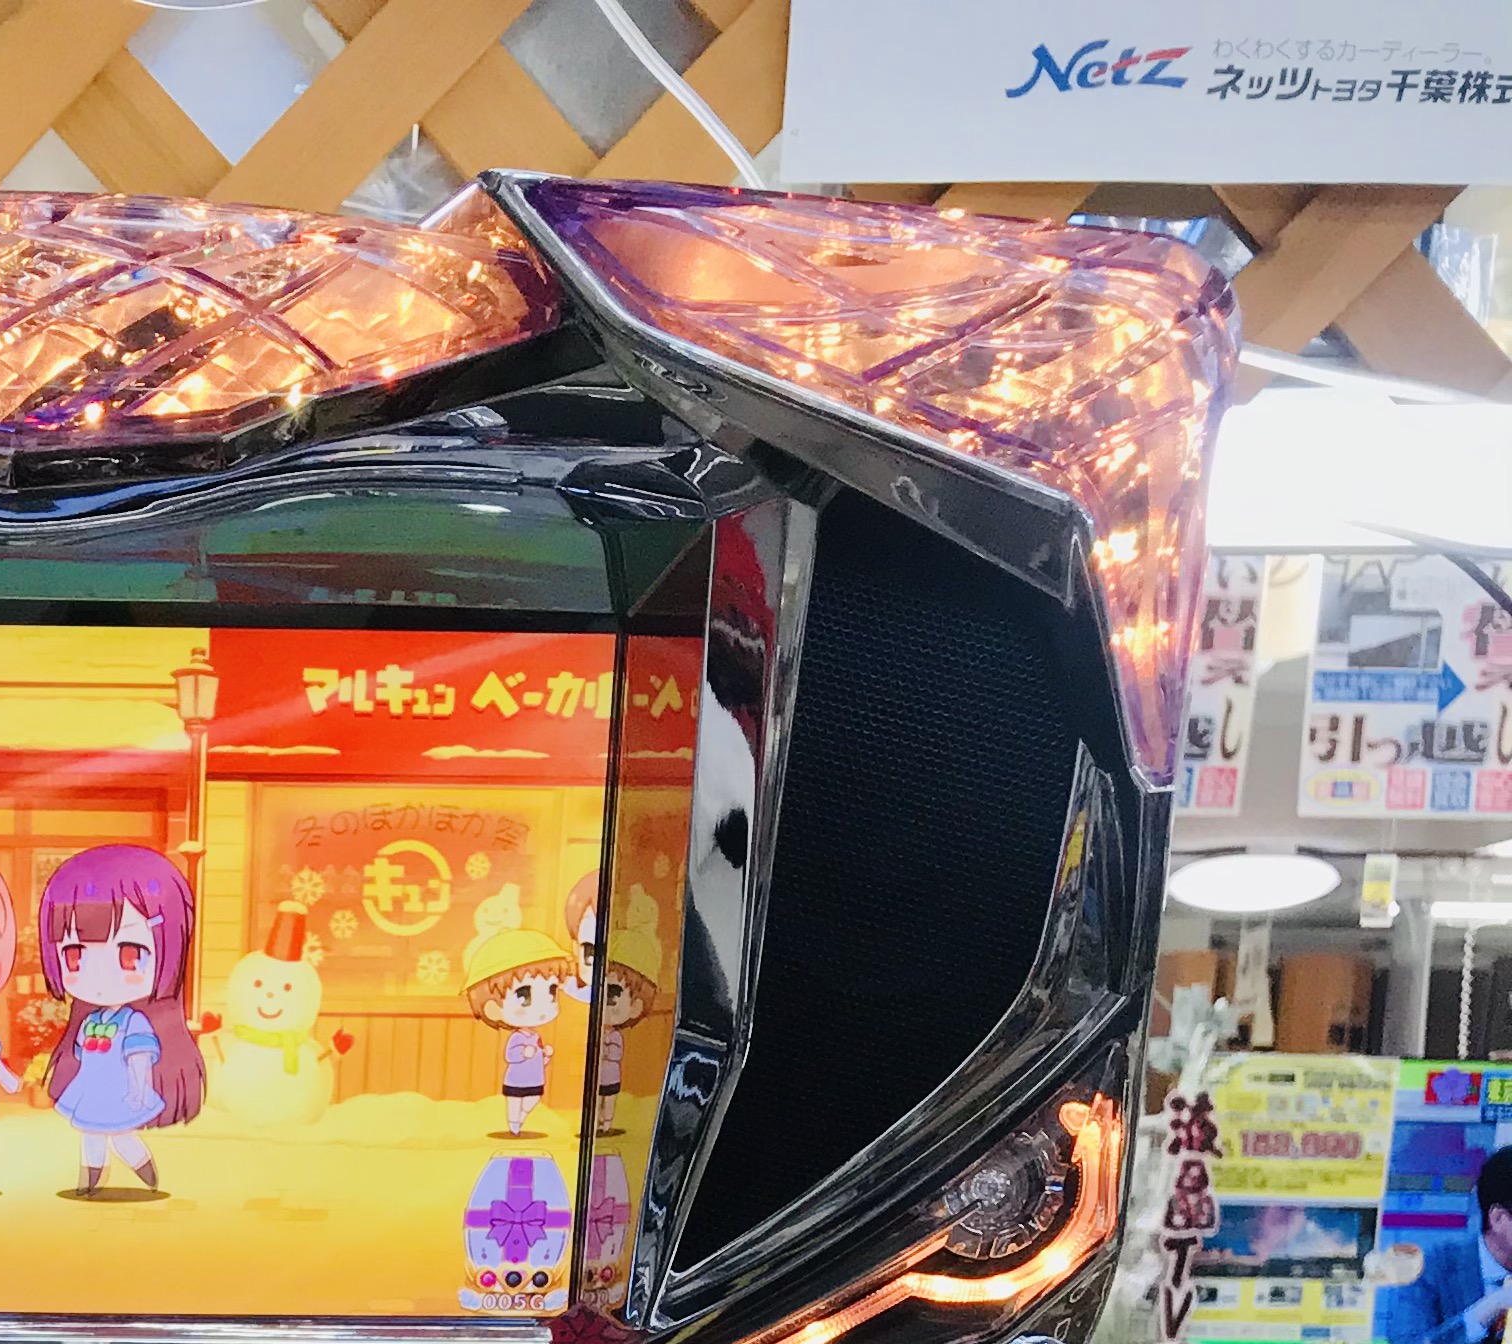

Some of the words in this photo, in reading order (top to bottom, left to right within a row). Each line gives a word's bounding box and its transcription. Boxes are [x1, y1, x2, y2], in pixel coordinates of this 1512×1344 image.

[1004, 38, 1192, 98] Netz
[302, 664, 456, 719] マルキュン
[482, 1295, 544, 1311] 005G
